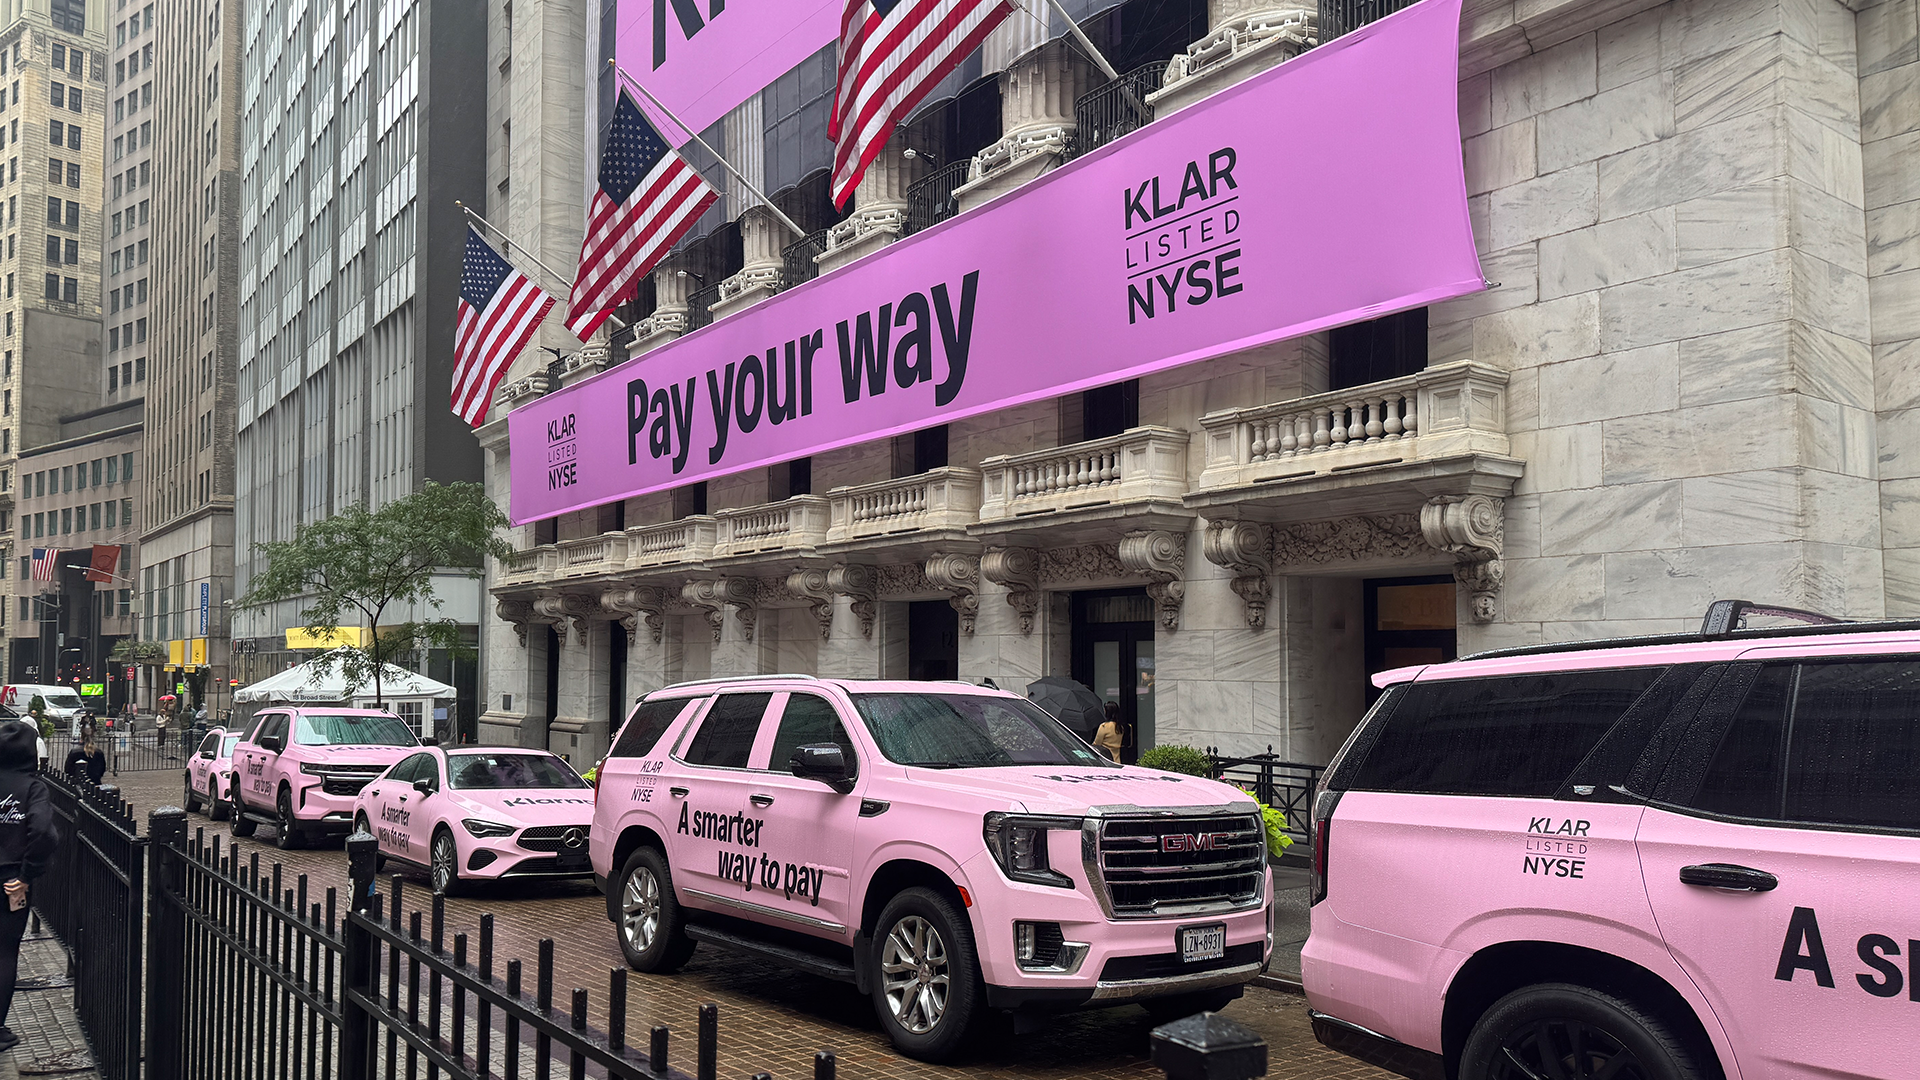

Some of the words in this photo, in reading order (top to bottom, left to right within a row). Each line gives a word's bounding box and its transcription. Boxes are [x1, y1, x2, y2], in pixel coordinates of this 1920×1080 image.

[1124, 146, 1238, 230] KLAR
[1126, 209, 1240, 269] LISTED
[1127, 247, 1243, 325] NYSE
[627, 376, 697, 475] Pay
[706, 328, 823, 465] your
[835, 269, 980, 407] way
[547, 413, 576, 443] KLAR
[548, 443, 577, 463] LISTED
[548, 462, 577, 491] NYSE
[640, 760, 663, 773] KLAR
[636, 776, 657, 786] LISTED
[631, 788, 653, 803] NYSE
[380, 801, 386, 820] A
[386, 806, 410, 827] smarter
[677, 800, 689, 836] A
[692, 810, 763, 848] smarter
[1527, 816, 1591, 837] KLAR
[378, 826, 391, 848] way
[390, 826, 397, 846] to
[397, 832, 411, 854] pay
[1160, 832, 1230, 853] GMC
[1526, 839, 1588, 855] LISTED
[718, 850, 757, 892] way
[760, 852, 780, 890] to
[783, 862, 823, 907] pay
[1523, 855, 1586, 879] NYSE
[1774, 906, 1836, 989] A
